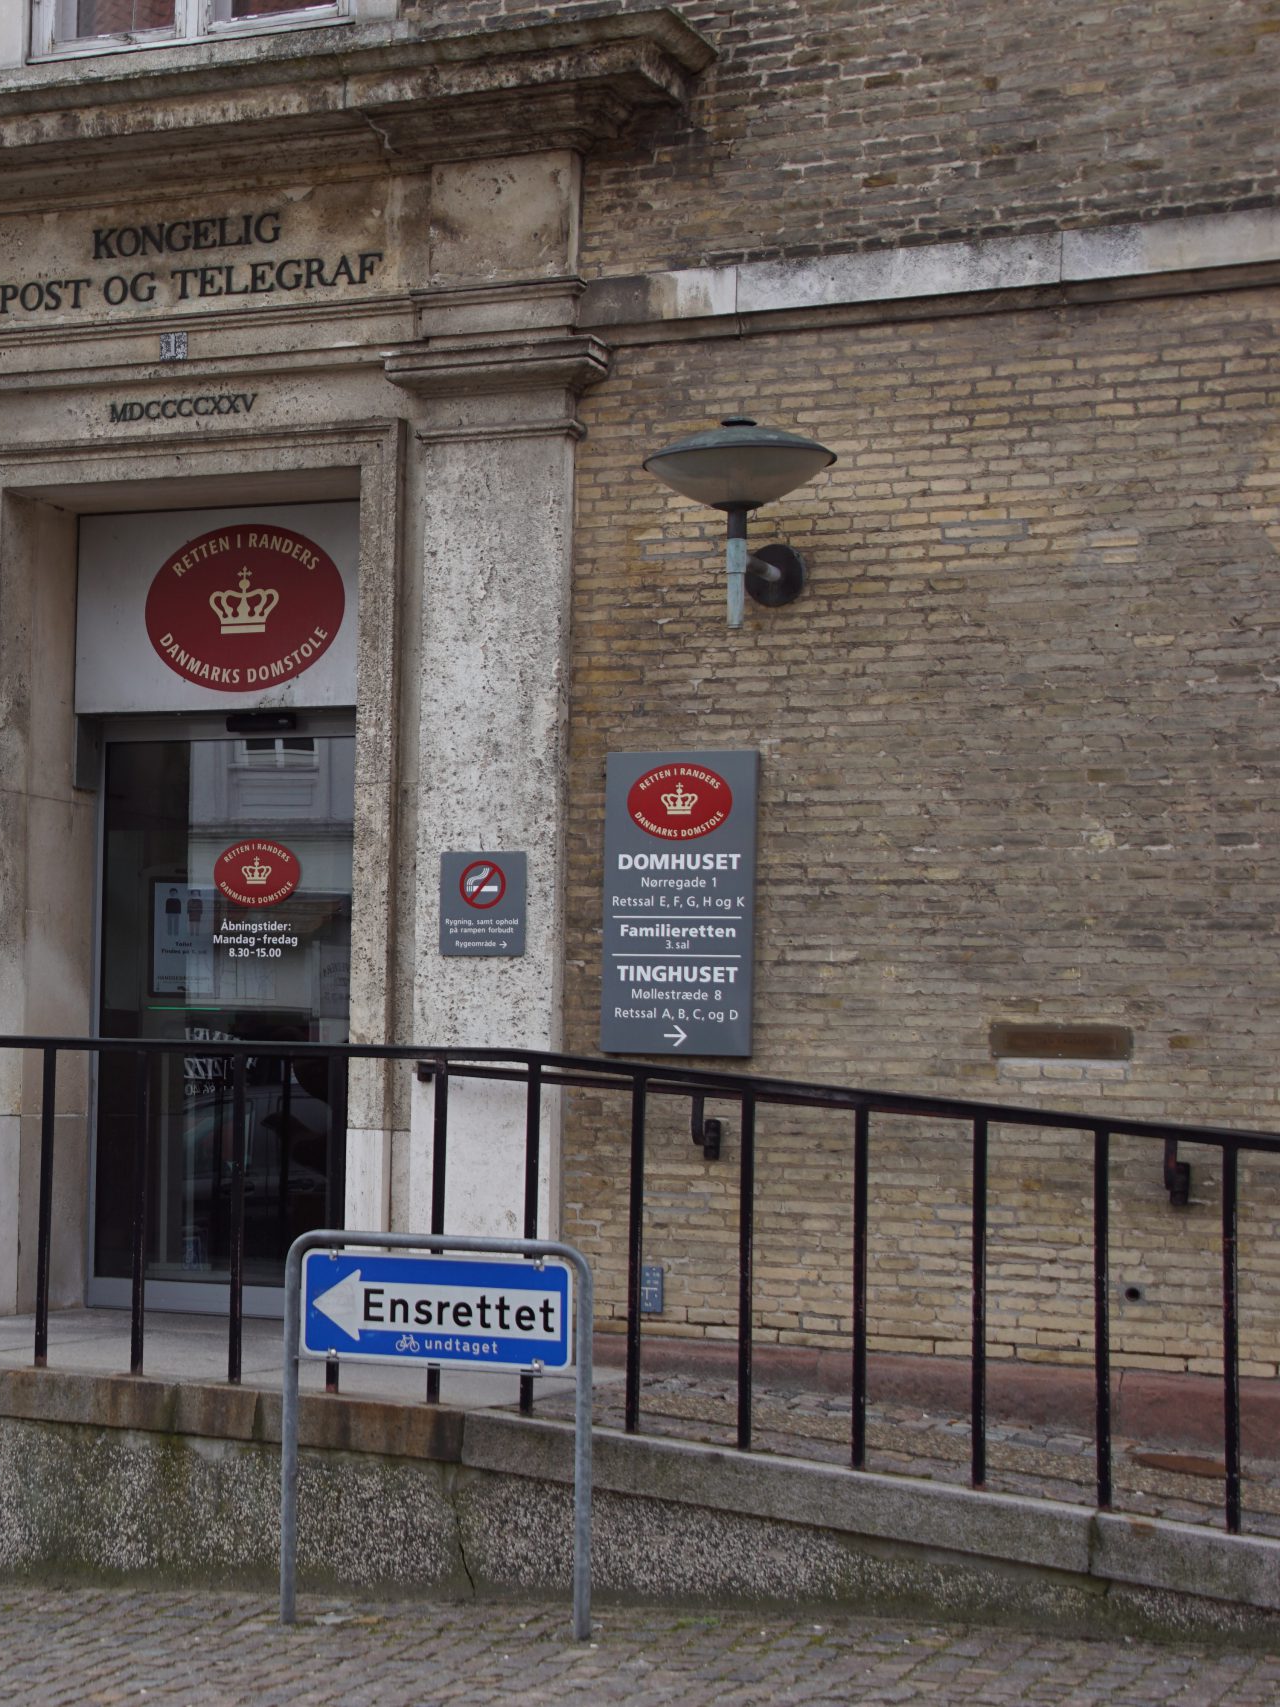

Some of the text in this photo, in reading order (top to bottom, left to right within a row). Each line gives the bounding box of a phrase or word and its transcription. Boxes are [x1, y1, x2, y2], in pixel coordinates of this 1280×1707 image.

[92, 212, 281, 260] KONGELIG
[0, 252, 384, 314] POST OG TELEGRAF
[108, 394, 258, 423] MDCCCCXXV
[172, 533, 320, 577] RETTEN I RANDERS
[159, 626, 328, 684] DANMARKS DOMSTOLE
[639, 768, 721, 790] RETTEN I RANDERS
[634, 810, 724, 838] DANMARKS DOMSTOLE
[223, 844, 250, 862] RETTEN
[257, 843, 291, 862] RANDERS
[618, 854, 742, 870] DOMHUSET
[641, 876, 717, 890] Nørregade 1
[220, 880, 294, 904] DANMARKS DOMSTOLE
[612, 896, 745, 910] Retssal E, F, G, H og K
[220, 918, 292, 932] Åbningstider:
[446, 918, 474, 926] Rygning,
[496, 918, 518, 926] ophold
[620, 924, 736, 938] Familieretten
[456, 940, 496, 948] Rygeområde
[676, 940, 690, 950] sal
[616, 966, 738, 983] TINGHUSET
[631, 988, 722, 1000] Møllestræde 8
[614, 1007, 738, 1022] Retssal A, B, C, og D
[362, 1288, 555, 1332] Ensrettet
[424, 1338, 498, 1356] undtaget
